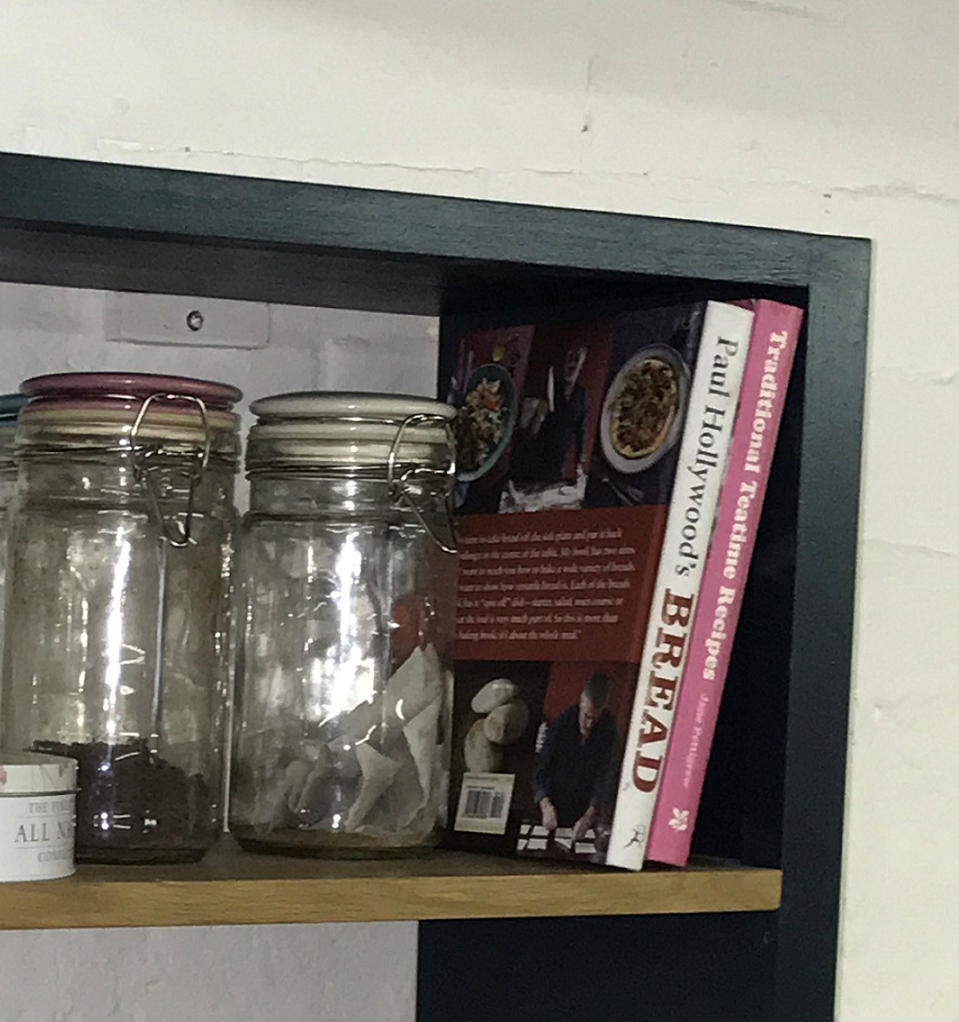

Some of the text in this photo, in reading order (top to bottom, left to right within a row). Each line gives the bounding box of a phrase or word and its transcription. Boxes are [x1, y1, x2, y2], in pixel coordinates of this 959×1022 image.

[632, 335, 739, 793] Paul Hollywood's BREAD
[702, 330, 788, 681] Traditional Teatime Recipes
[14, 823, 50, 842] ALL
